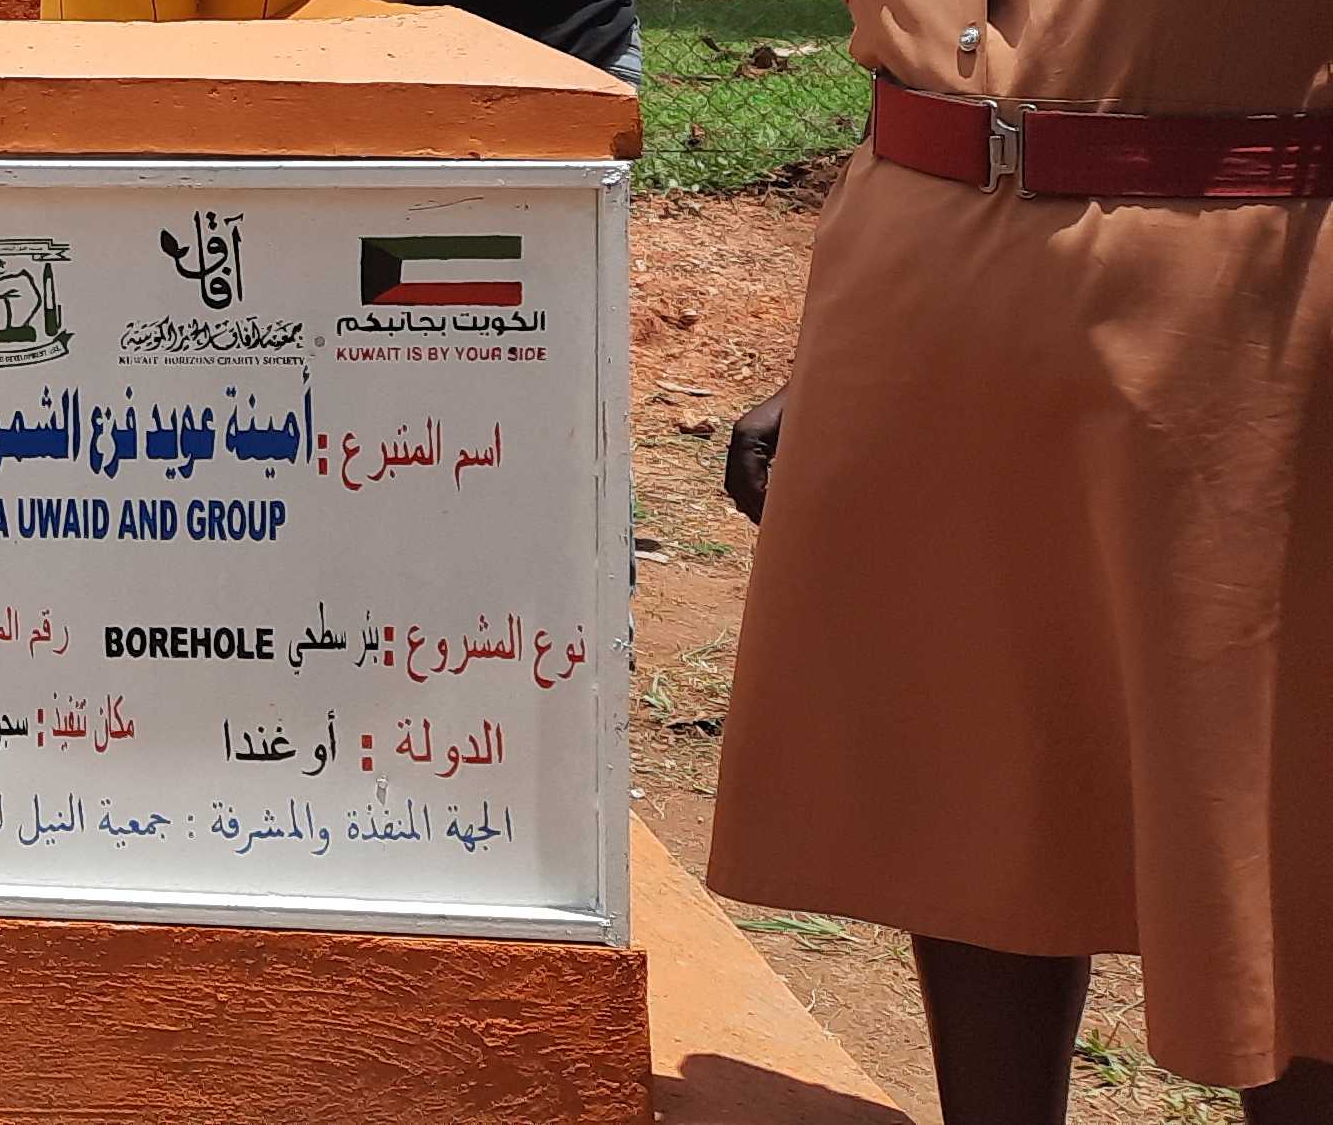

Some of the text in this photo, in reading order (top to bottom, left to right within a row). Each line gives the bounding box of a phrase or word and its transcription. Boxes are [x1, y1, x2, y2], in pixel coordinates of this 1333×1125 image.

[336, 310, 546, 337] الكويت بجانبكم
[118, 355, 305, 366] KUWAIT HORIZONS CHARITY SOCIETY
[336, 346, 547, 362] KUWAIT IS BY YOUR SIDE
[89, 386, 138, 480] فزع
[145, 403, 216, 480] عويد
[225, 362, 313, 479] أمينة
[454, 421, 501, 492] اسم
[17, 497, 110, 540] UWAID
[117, 498, 178, 541] AND
[186, 499, 286, 542] GROUP
[29, 609, 69, 659] رقم
[104, 626, 275, 660] BOREHOLE
[288, 601, 347, 676] سطحي
[533, 625, 586, 690] نوع
[94, 694, 135, 753] مكان
[223, 708, 337, 777] أوغندا
[395, 718, 503, 779] الدولة
[18, 792, 85, 846] النيل
[98, 798, 172, 849] جمعية
[211, 798, 330, 856] والمشرفة
[345, 795, 435, 845] المنفذة
[446, 800, 512, 853] الجهة
